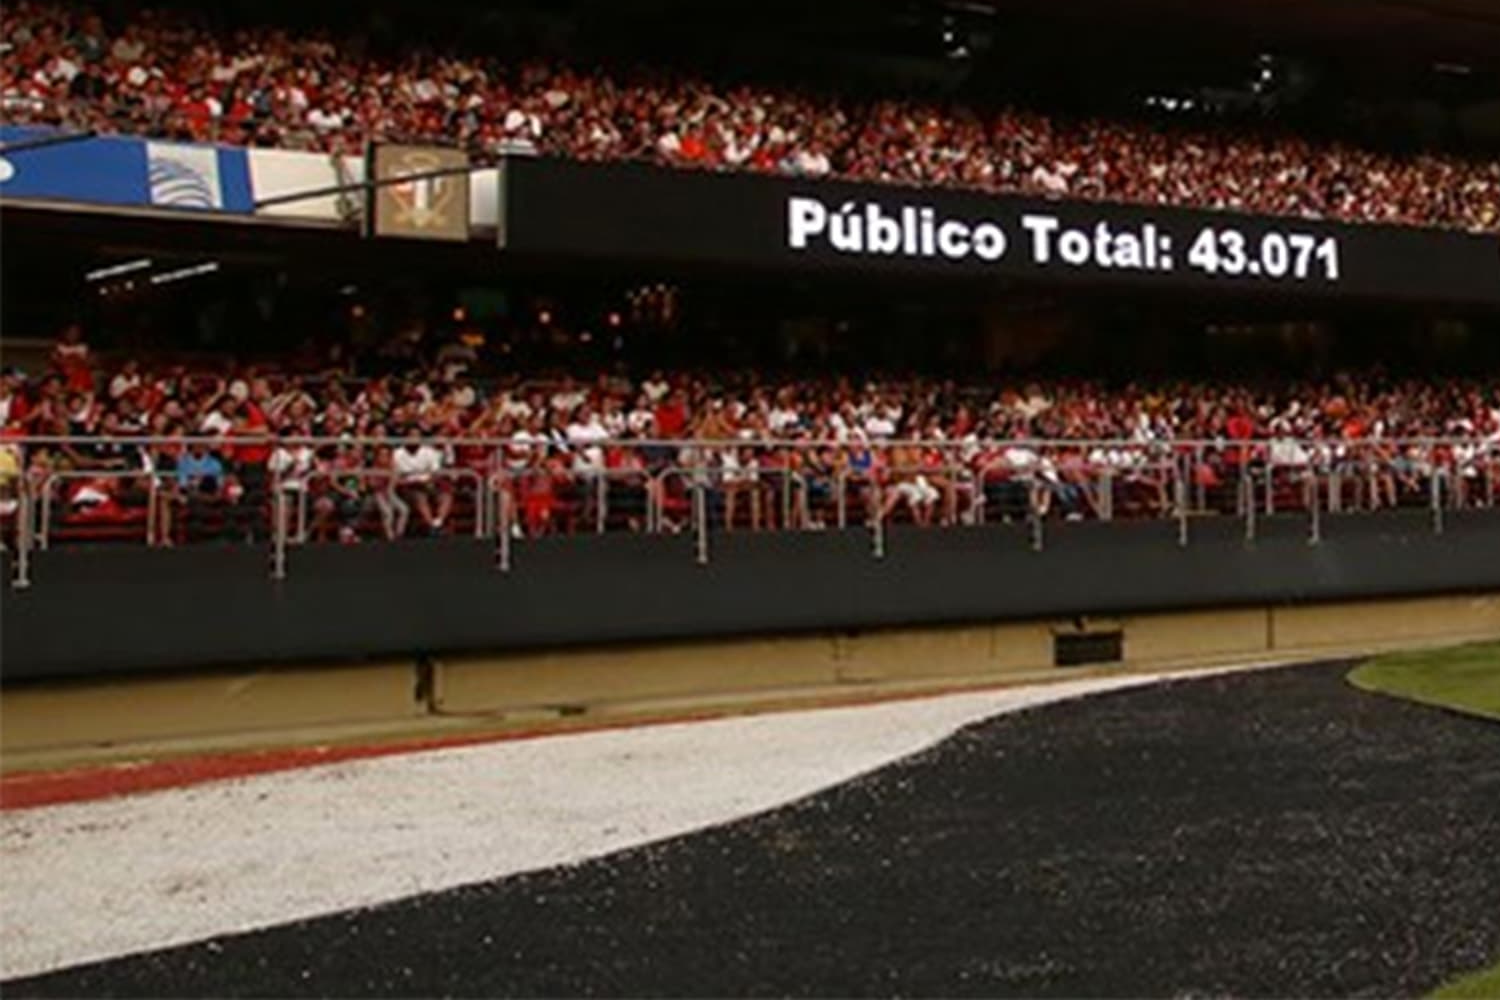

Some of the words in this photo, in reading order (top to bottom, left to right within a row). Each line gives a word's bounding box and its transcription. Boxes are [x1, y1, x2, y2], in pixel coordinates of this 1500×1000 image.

[789, 197, 1006, 260] Público
[1022, 215, 1173, 270] Total:
[1188, 228, 1339, 280] 43.071
